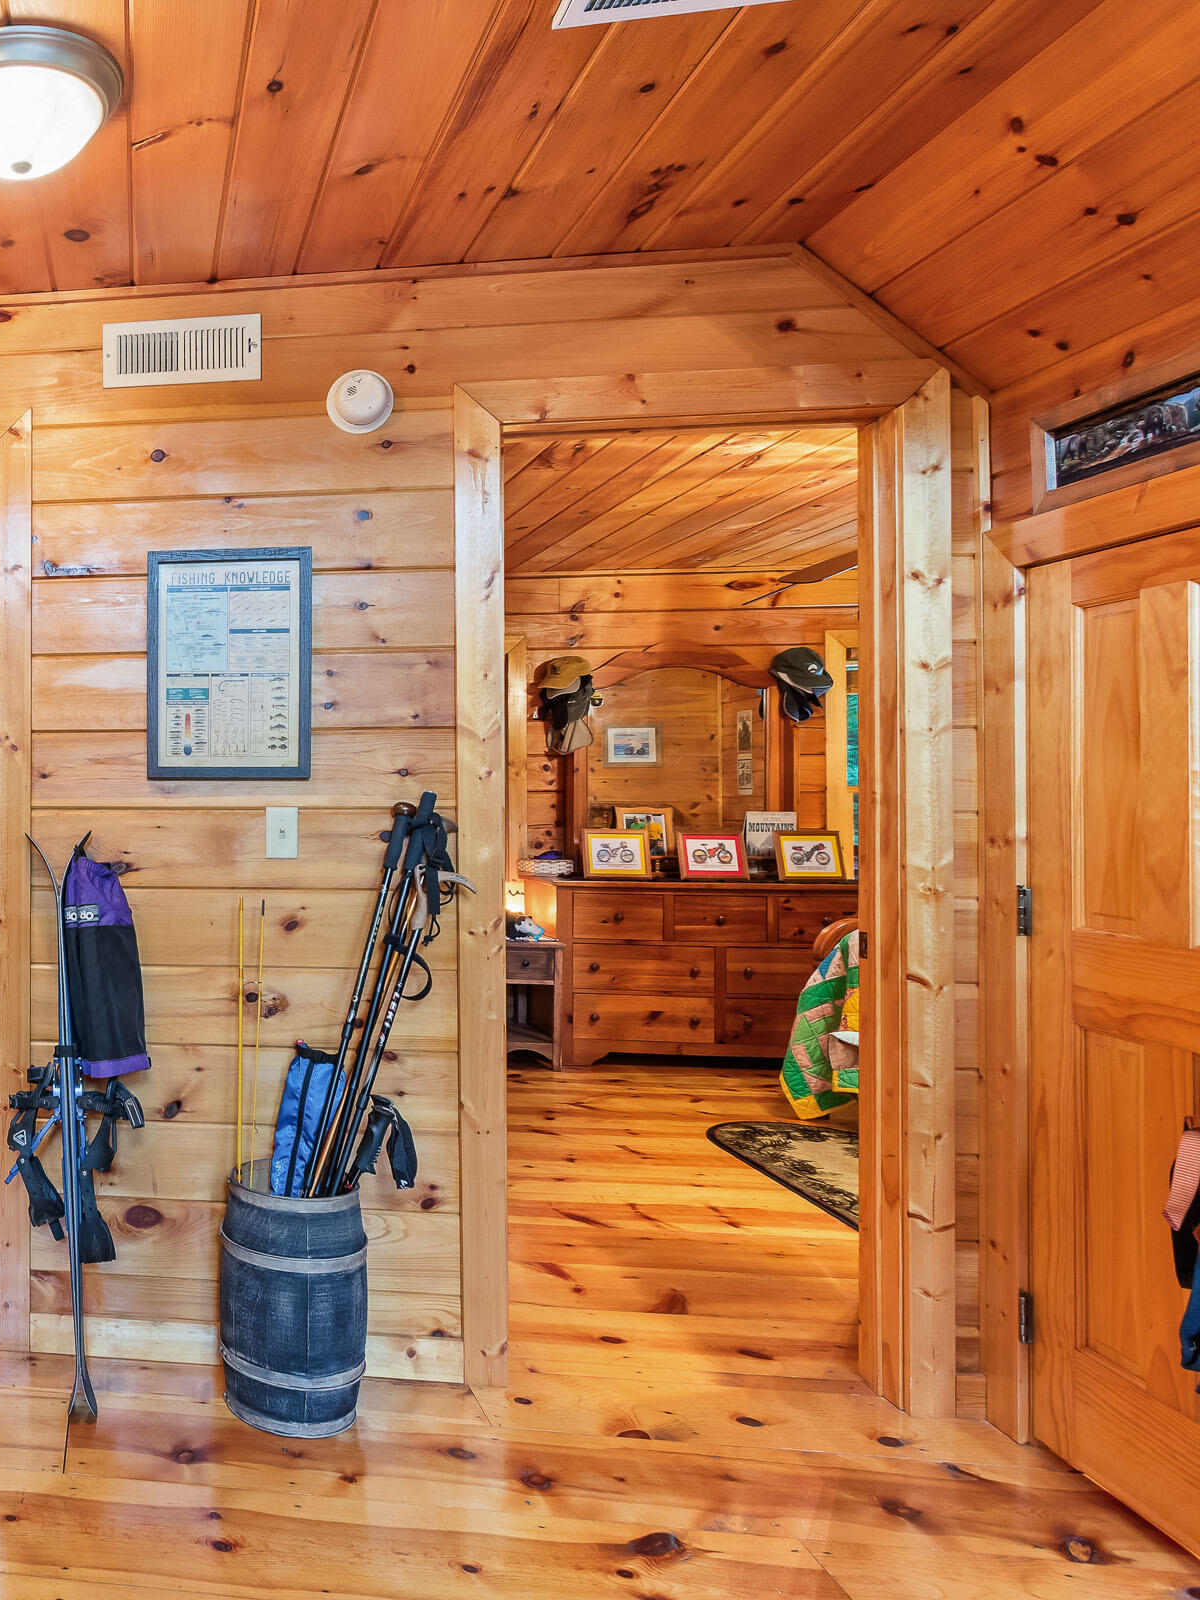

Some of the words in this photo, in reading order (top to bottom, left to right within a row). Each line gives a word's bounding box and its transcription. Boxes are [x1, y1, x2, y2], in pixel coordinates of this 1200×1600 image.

[171, 572, 216, 585] FISHING
[224, 571, 291, 585] KNOWLEDGE
[748, 822, 794, 832] MOUNTAINS
[384, 991, 400, 1028] LEKI
